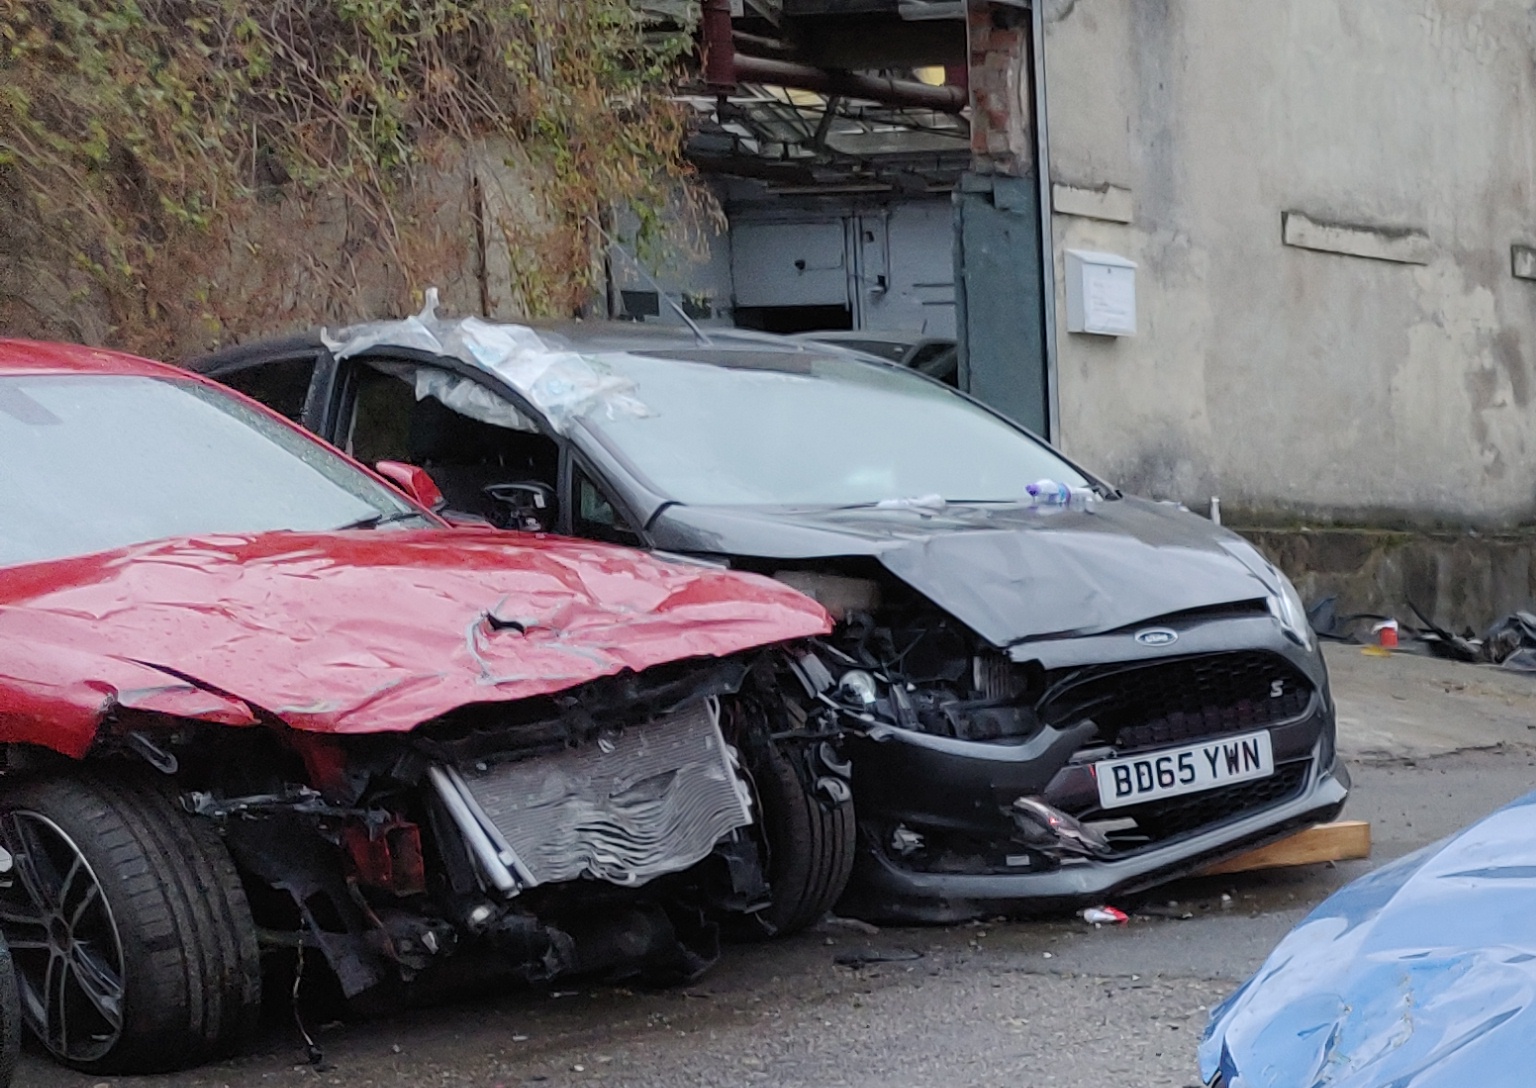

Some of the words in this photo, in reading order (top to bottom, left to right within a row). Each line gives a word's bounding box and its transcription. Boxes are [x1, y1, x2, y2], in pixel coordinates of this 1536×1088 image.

[1270, 680, 1284, 698] S
[1111, 752, 1196, 798] BD65
[1203, 738, 1261, 778] YWN
